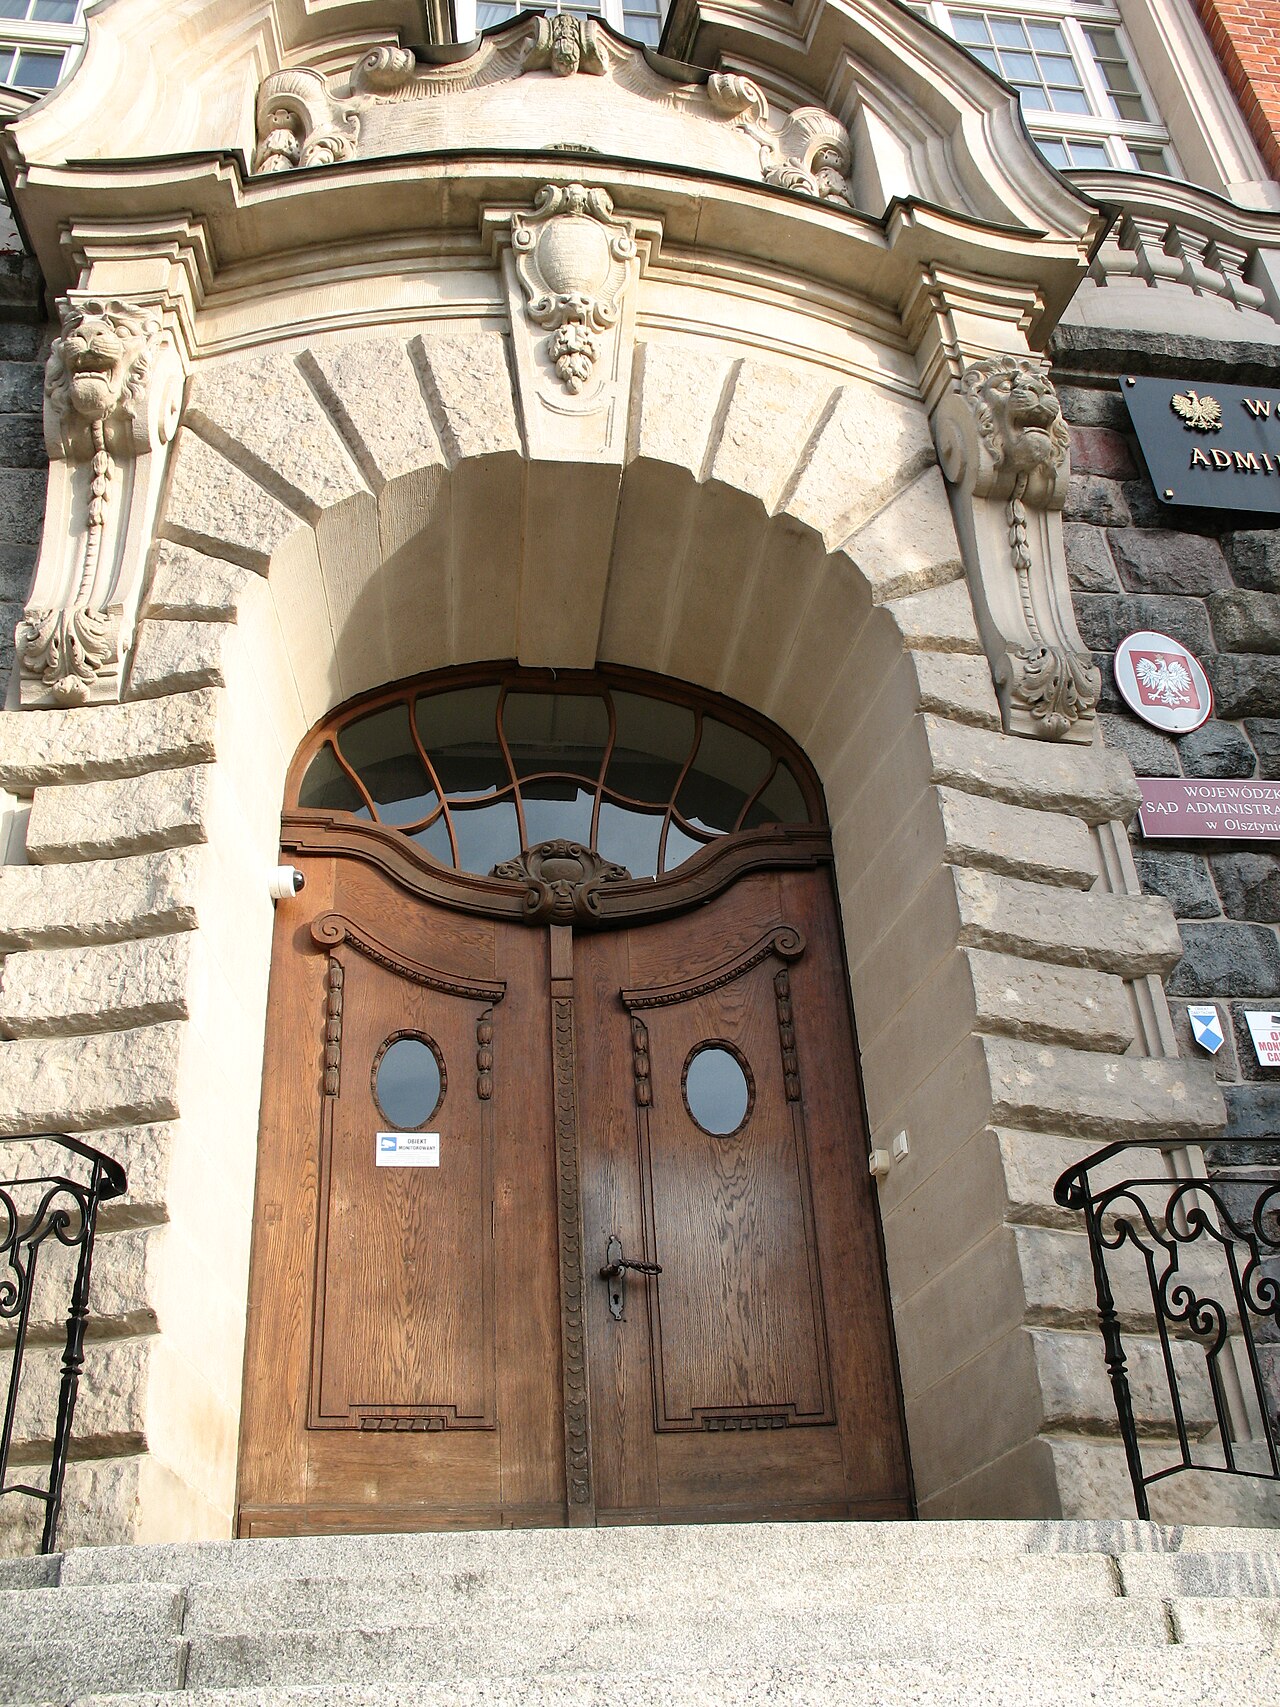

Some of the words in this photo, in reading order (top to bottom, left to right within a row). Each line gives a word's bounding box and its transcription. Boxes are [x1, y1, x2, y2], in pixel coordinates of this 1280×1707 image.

[1242, 398, 1280, 419] W
[1145, 801, 1179, 816] SĄD
[1206, 821, 1218, 830] w
[1224, 819, 1280, 834] Olsztyni
[1270, 1031, 1280, 1041] O
[1258, 1041, 1280, 1052] MON
[1267, 1052, 1280, 1062] CA
